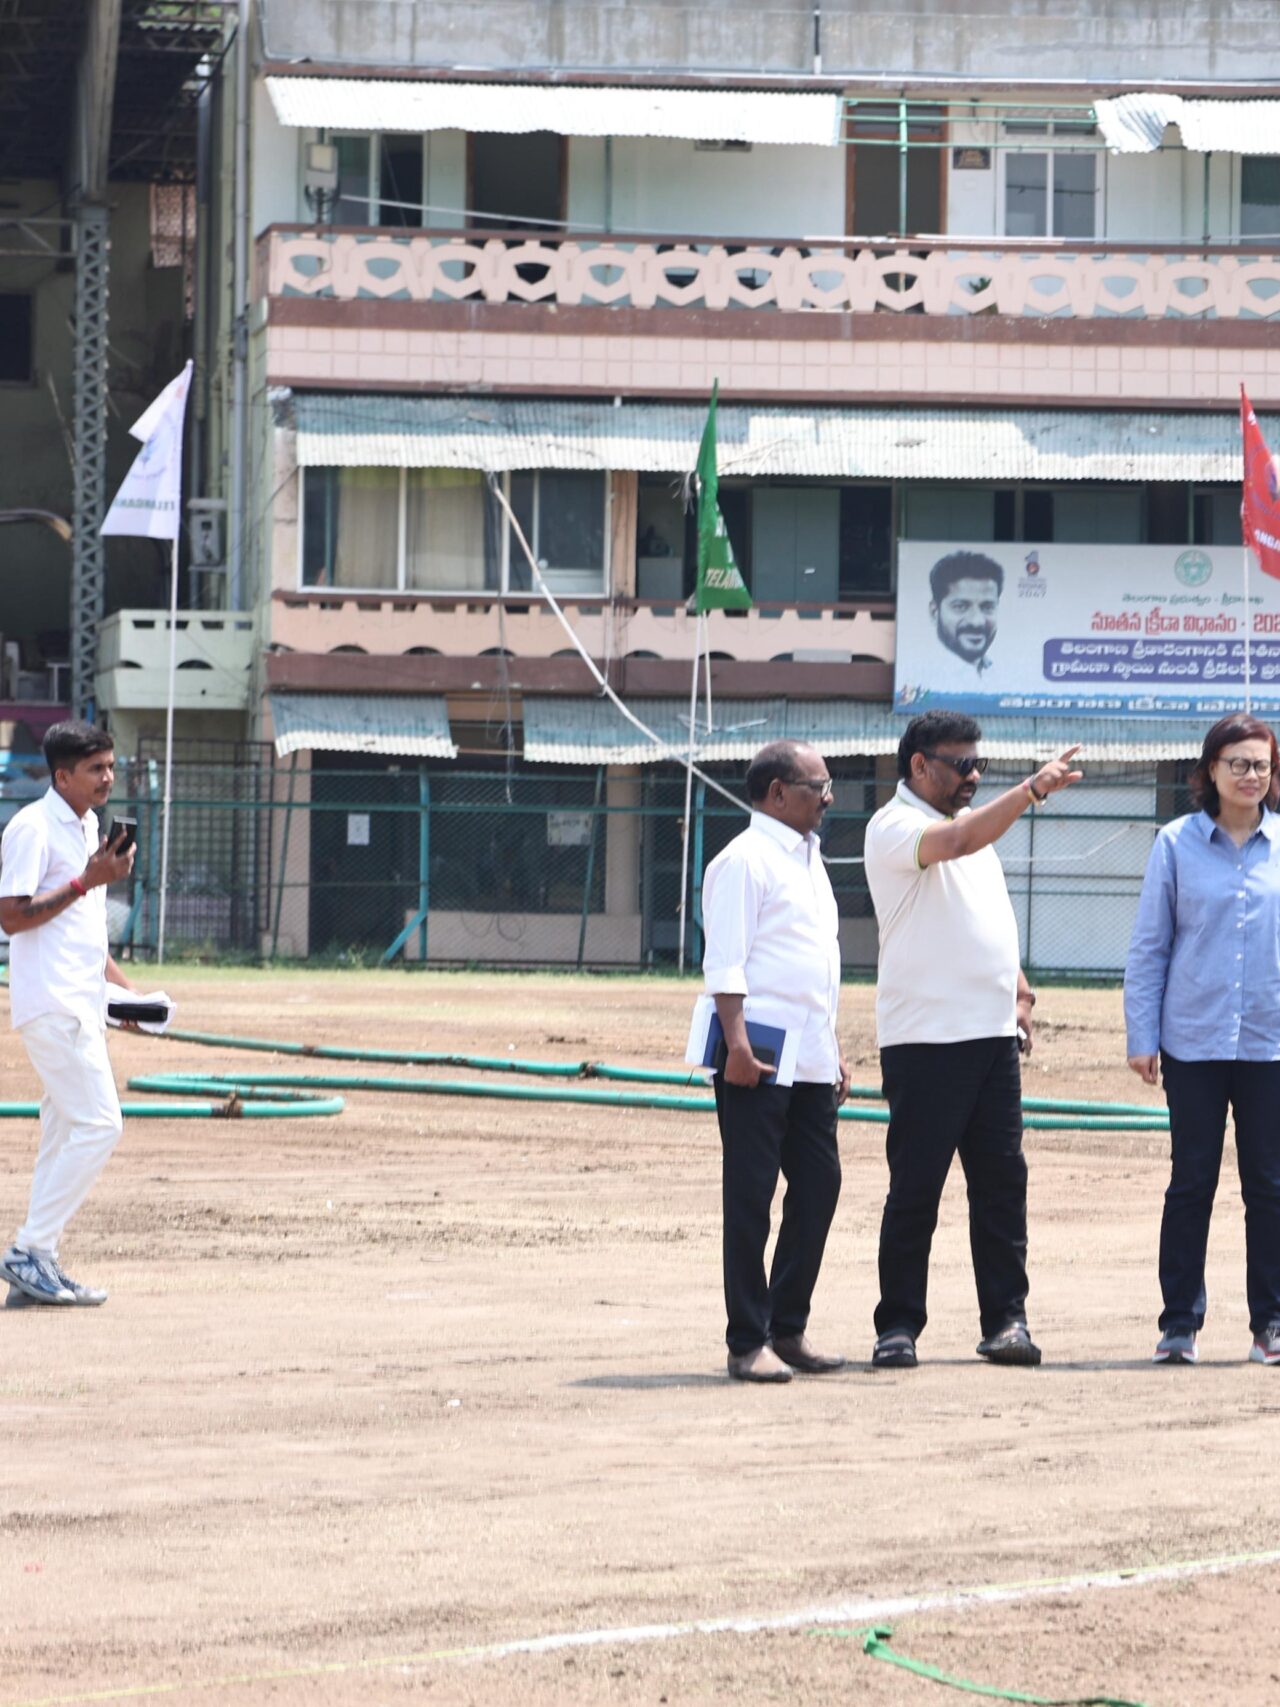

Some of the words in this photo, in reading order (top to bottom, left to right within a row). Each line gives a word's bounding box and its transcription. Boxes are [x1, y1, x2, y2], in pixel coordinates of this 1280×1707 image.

[1091, 611, 1141, 631] నూతన
[1145, 606, 1179, 635] క్రీడా
[1183, 613, 1236, 635] విధానం
[1060, 642, 1129, 655] తెలంగాణ
